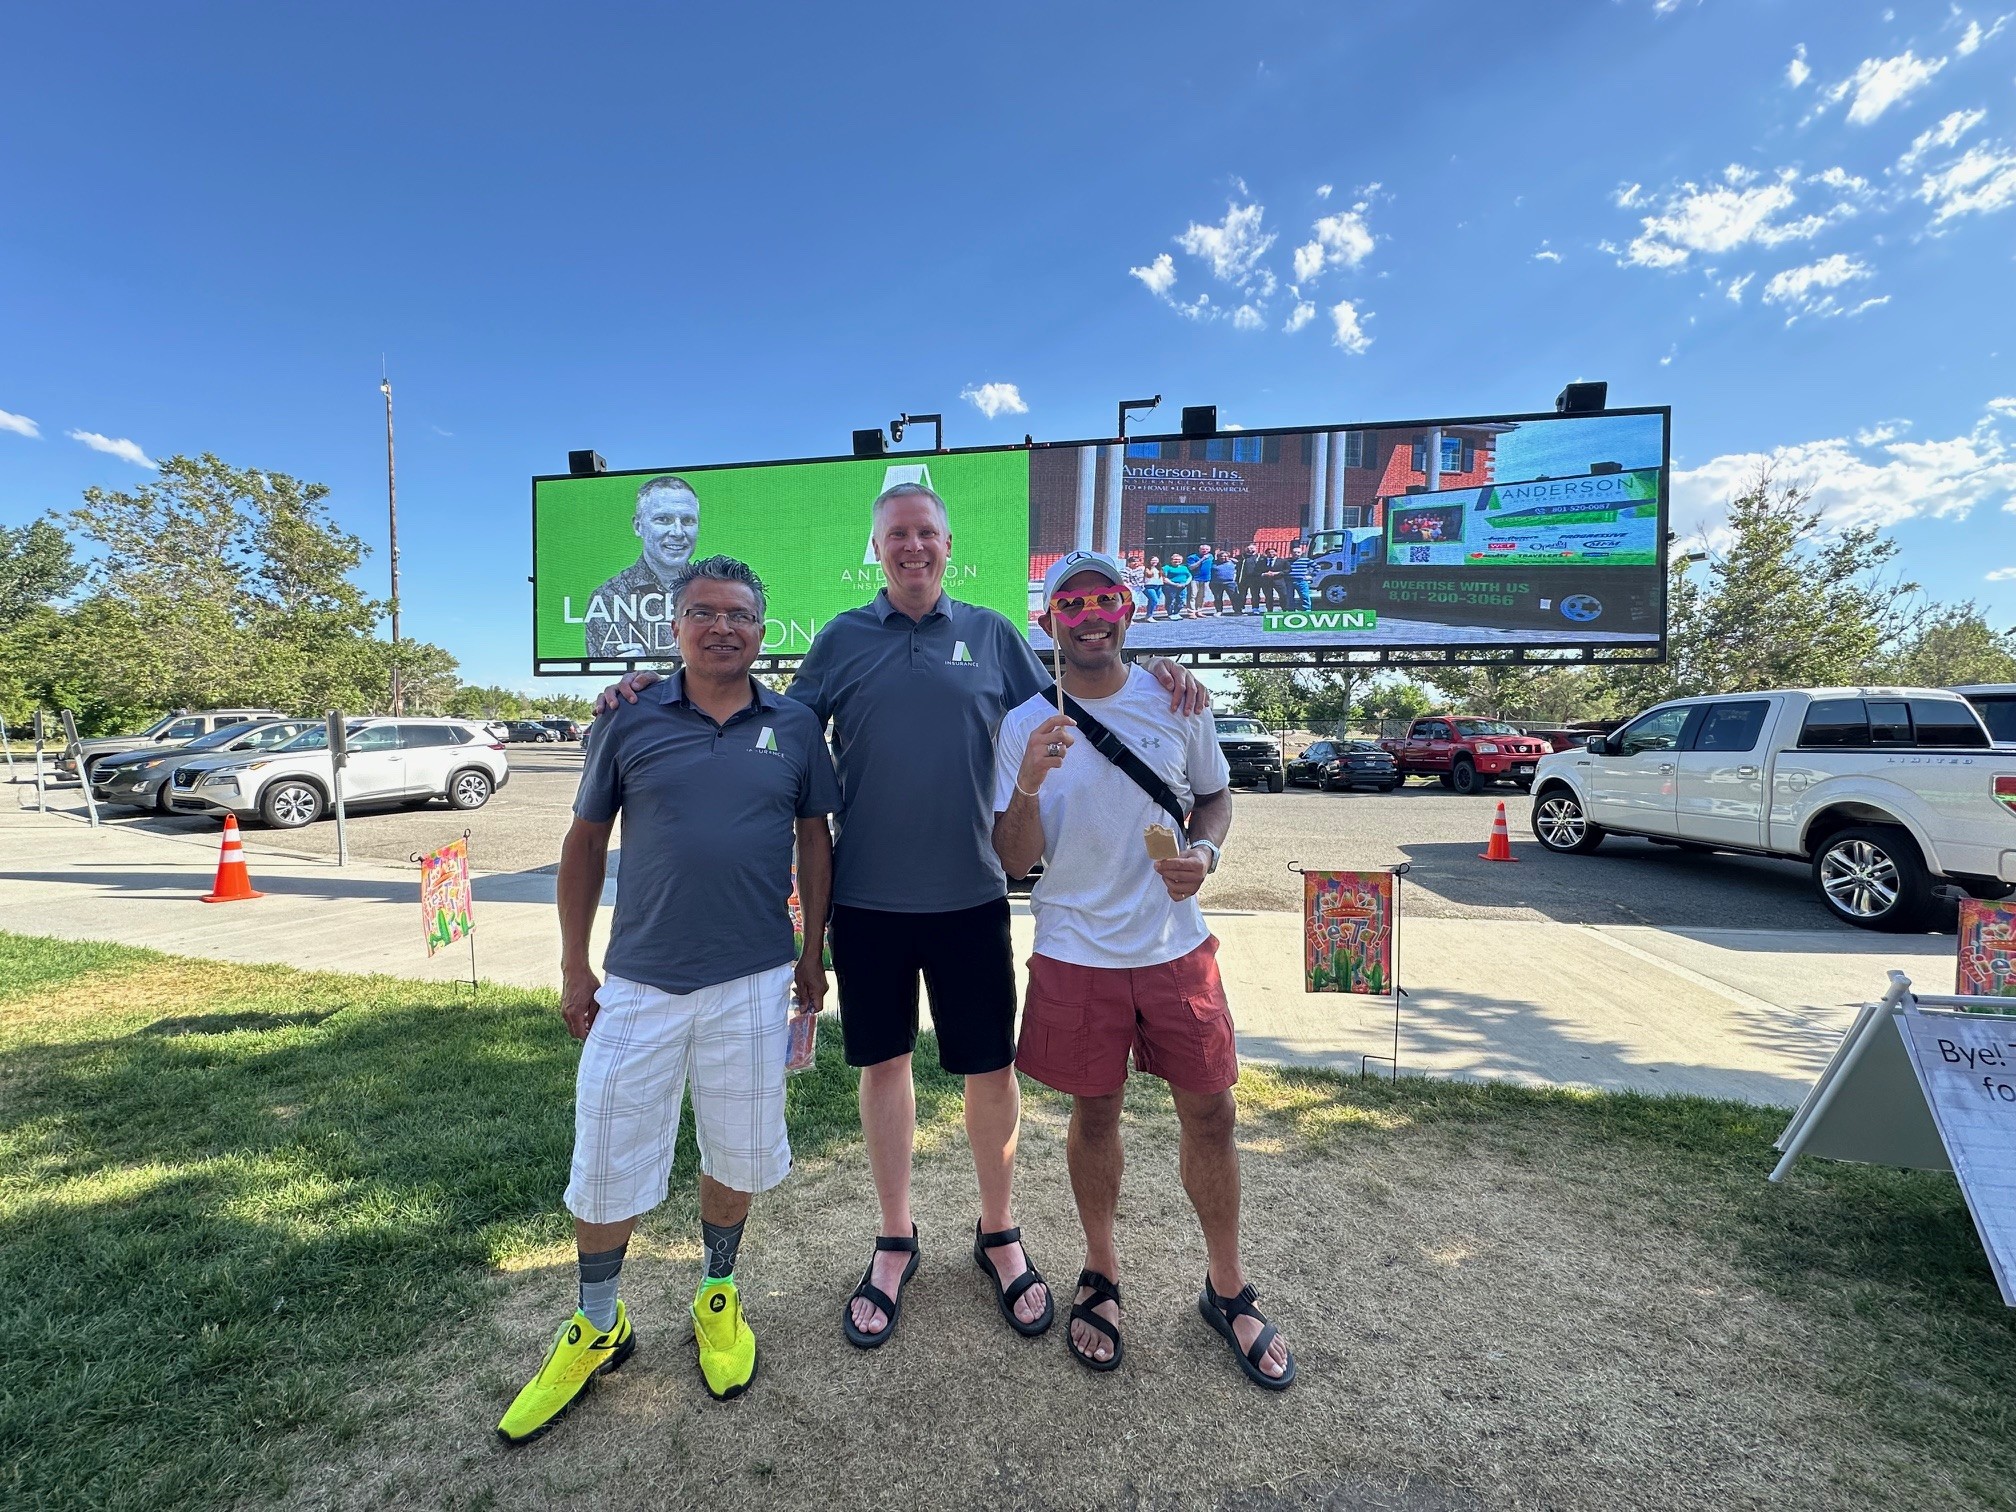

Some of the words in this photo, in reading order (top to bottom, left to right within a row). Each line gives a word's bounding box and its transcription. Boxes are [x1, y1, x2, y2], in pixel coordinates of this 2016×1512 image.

[1212, 467, 1242, 479] Ins.
[1502, 478, 1634, 499] ANDERSON
[841, 564, 977, 583] ANDON
[1382, 580, 1456, 591] ADVERTISE
[1460, 581, 1500, 592] WITH
[1506, 583, 1530, 593] US
[1265, 613, 1374, 629] TOWN.
[601, 618, 815, 650] ANDON
[1938, 1039, 2006, 1069] Bye!
[1983, 1076, 2016, 1103] fo
